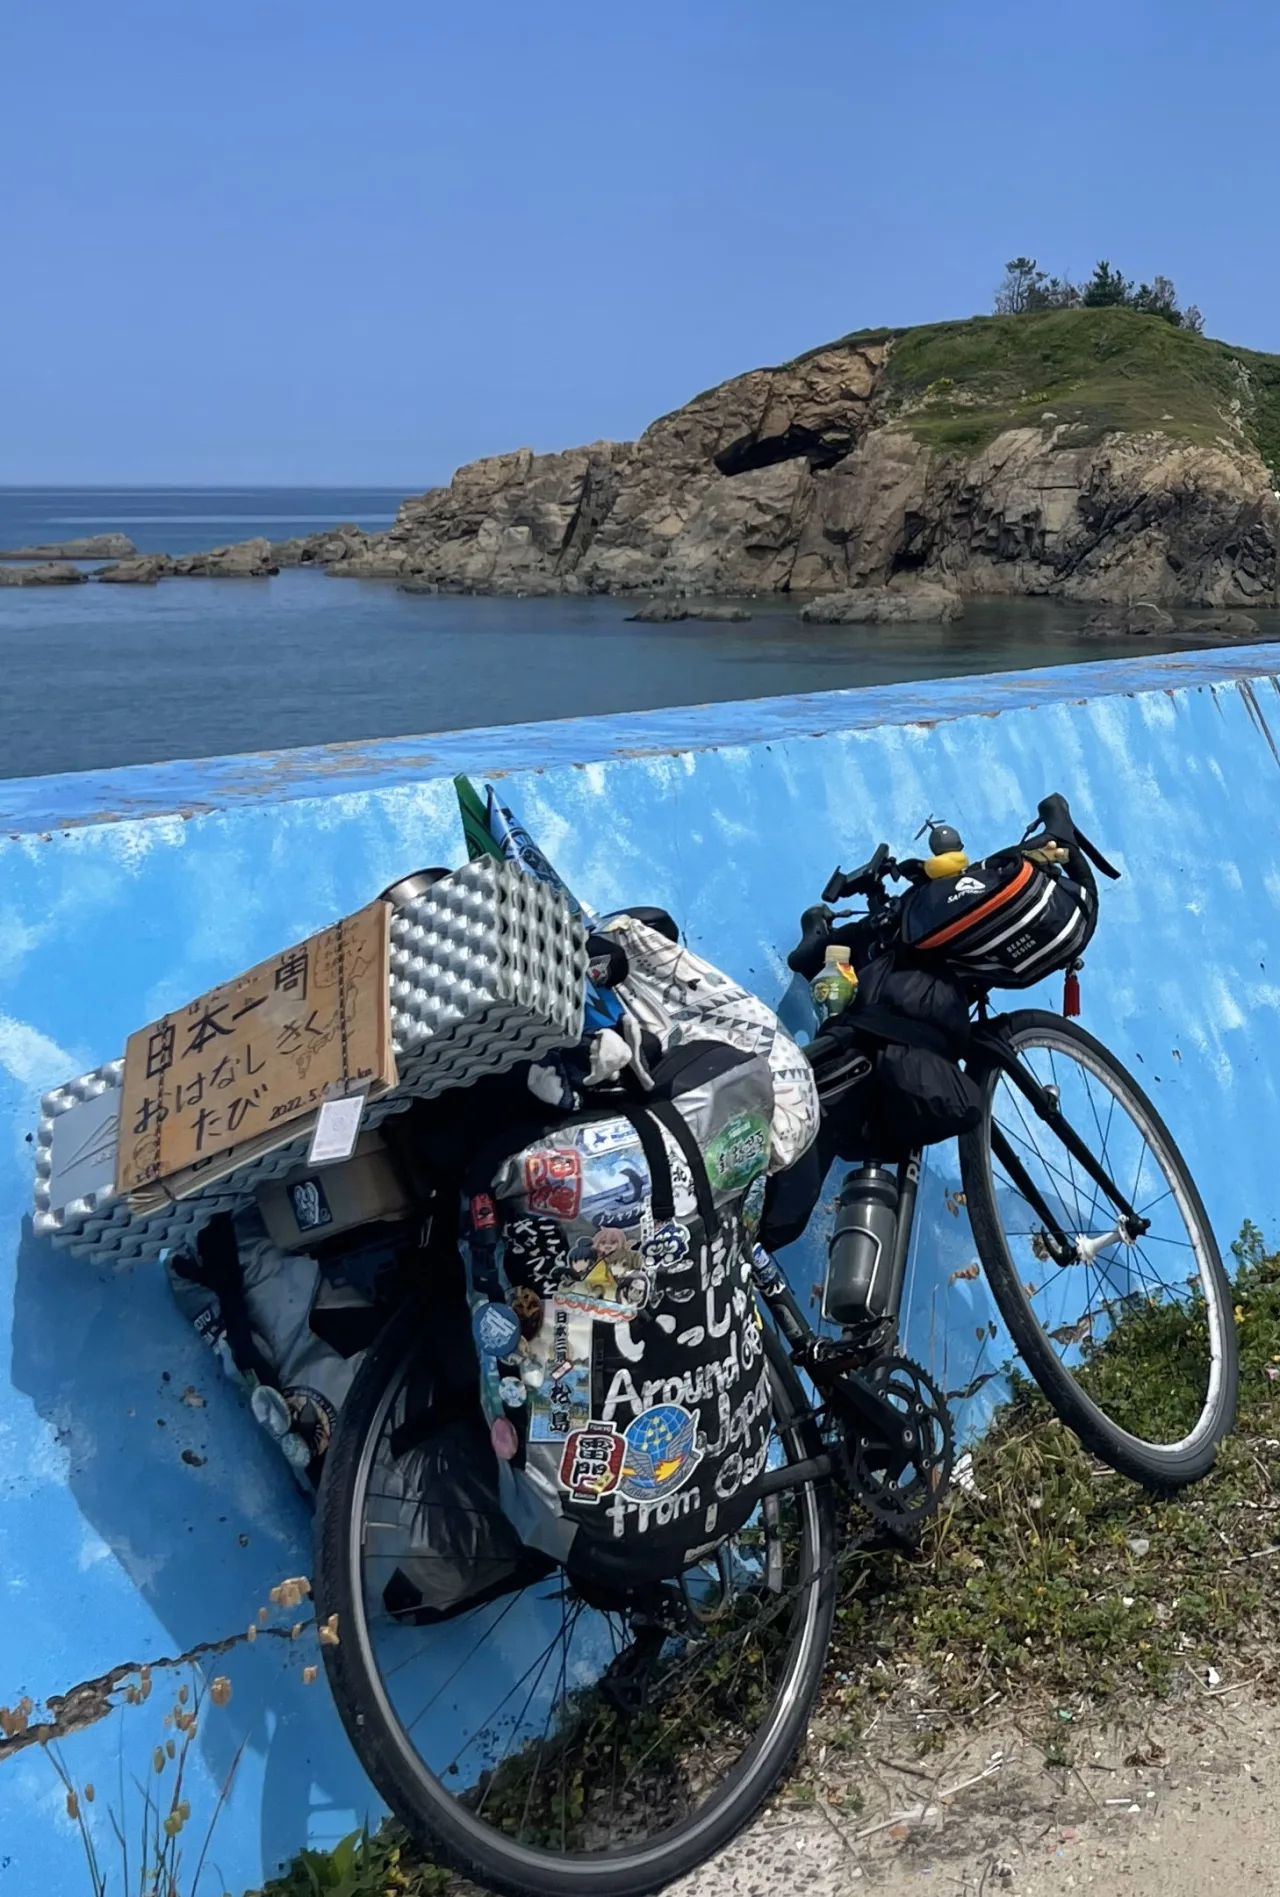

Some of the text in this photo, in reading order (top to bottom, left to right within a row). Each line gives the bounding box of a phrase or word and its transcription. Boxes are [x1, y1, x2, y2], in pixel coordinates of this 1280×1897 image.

[146, 953, 308, 1080] 日本一周
[190, 1083, 269, 1151] たび
[550, 1380, 573, 1433] 松島
[602, 1329, 741, 1421] Around
